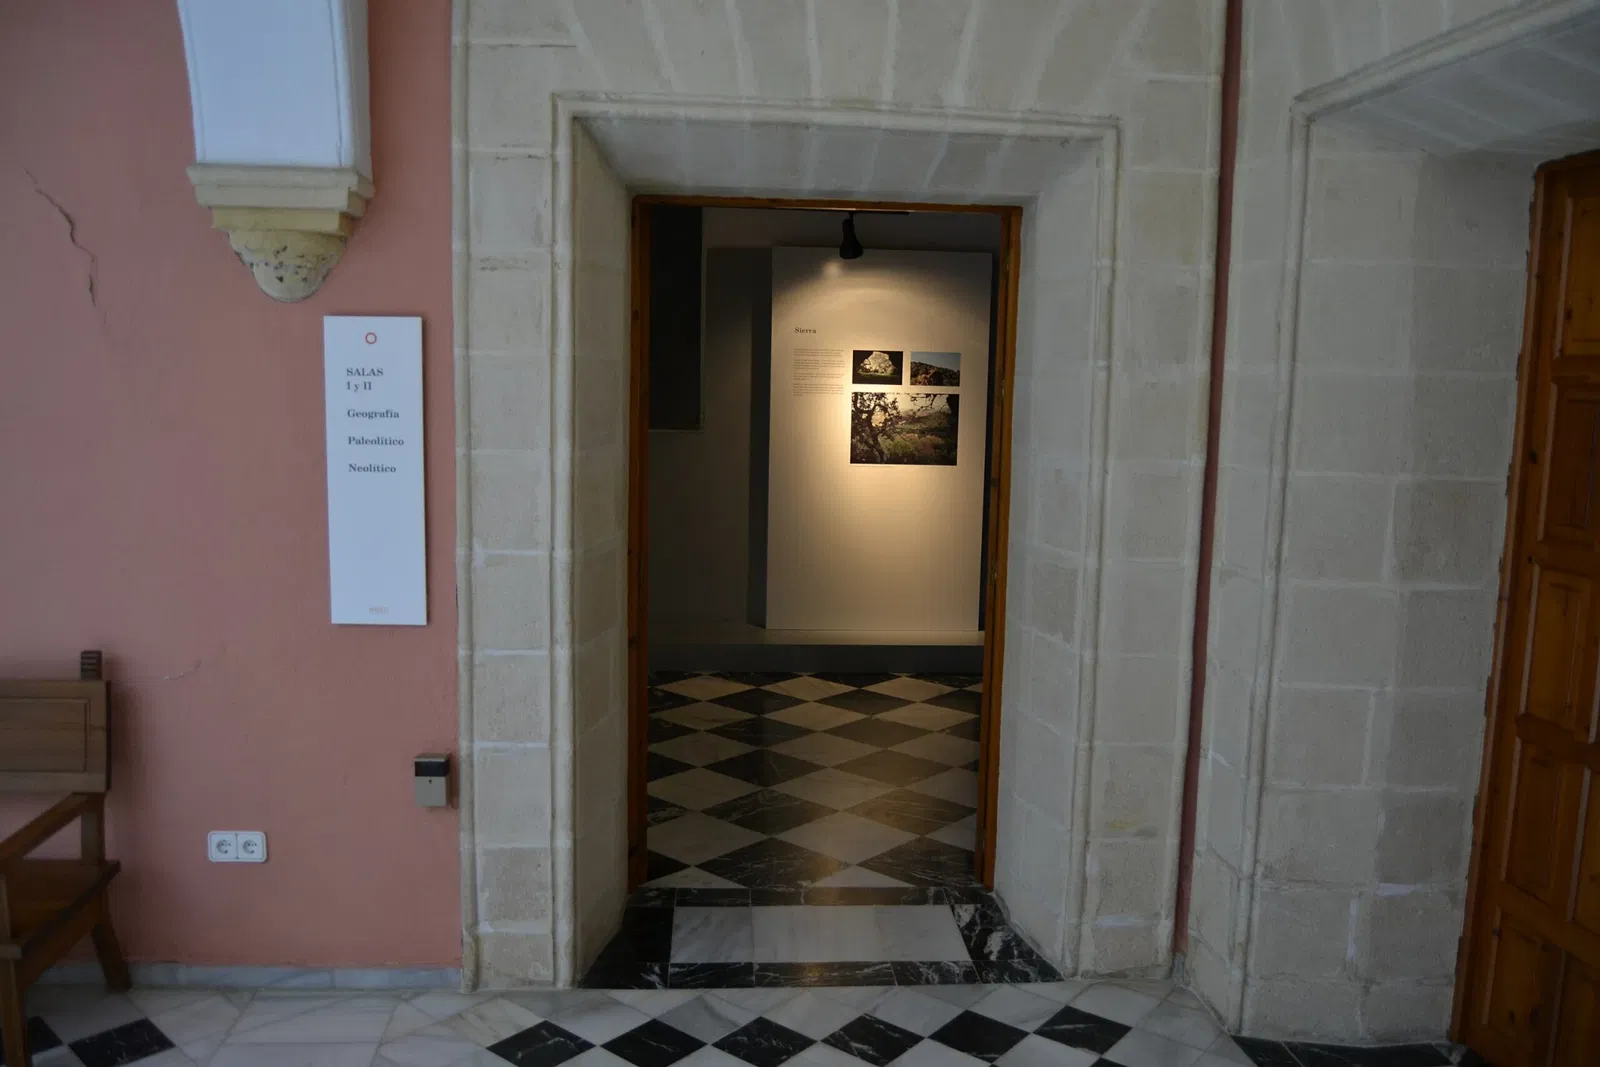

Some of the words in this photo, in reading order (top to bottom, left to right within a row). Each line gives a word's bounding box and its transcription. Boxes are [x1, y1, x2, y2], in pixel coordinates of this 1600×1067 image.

[794, 326, 817, 334] Sierra
[346, 367, 384, 377] SALAS
[346, 381, 351, 390] I
[353, 383, 360, 392] y
[363, 381, 372, 391] II
[347, 408, 400, 420] Geografía
[348, 435, 404, 445] Paleolítico
[348, 463, 397, 473] Neolítico
